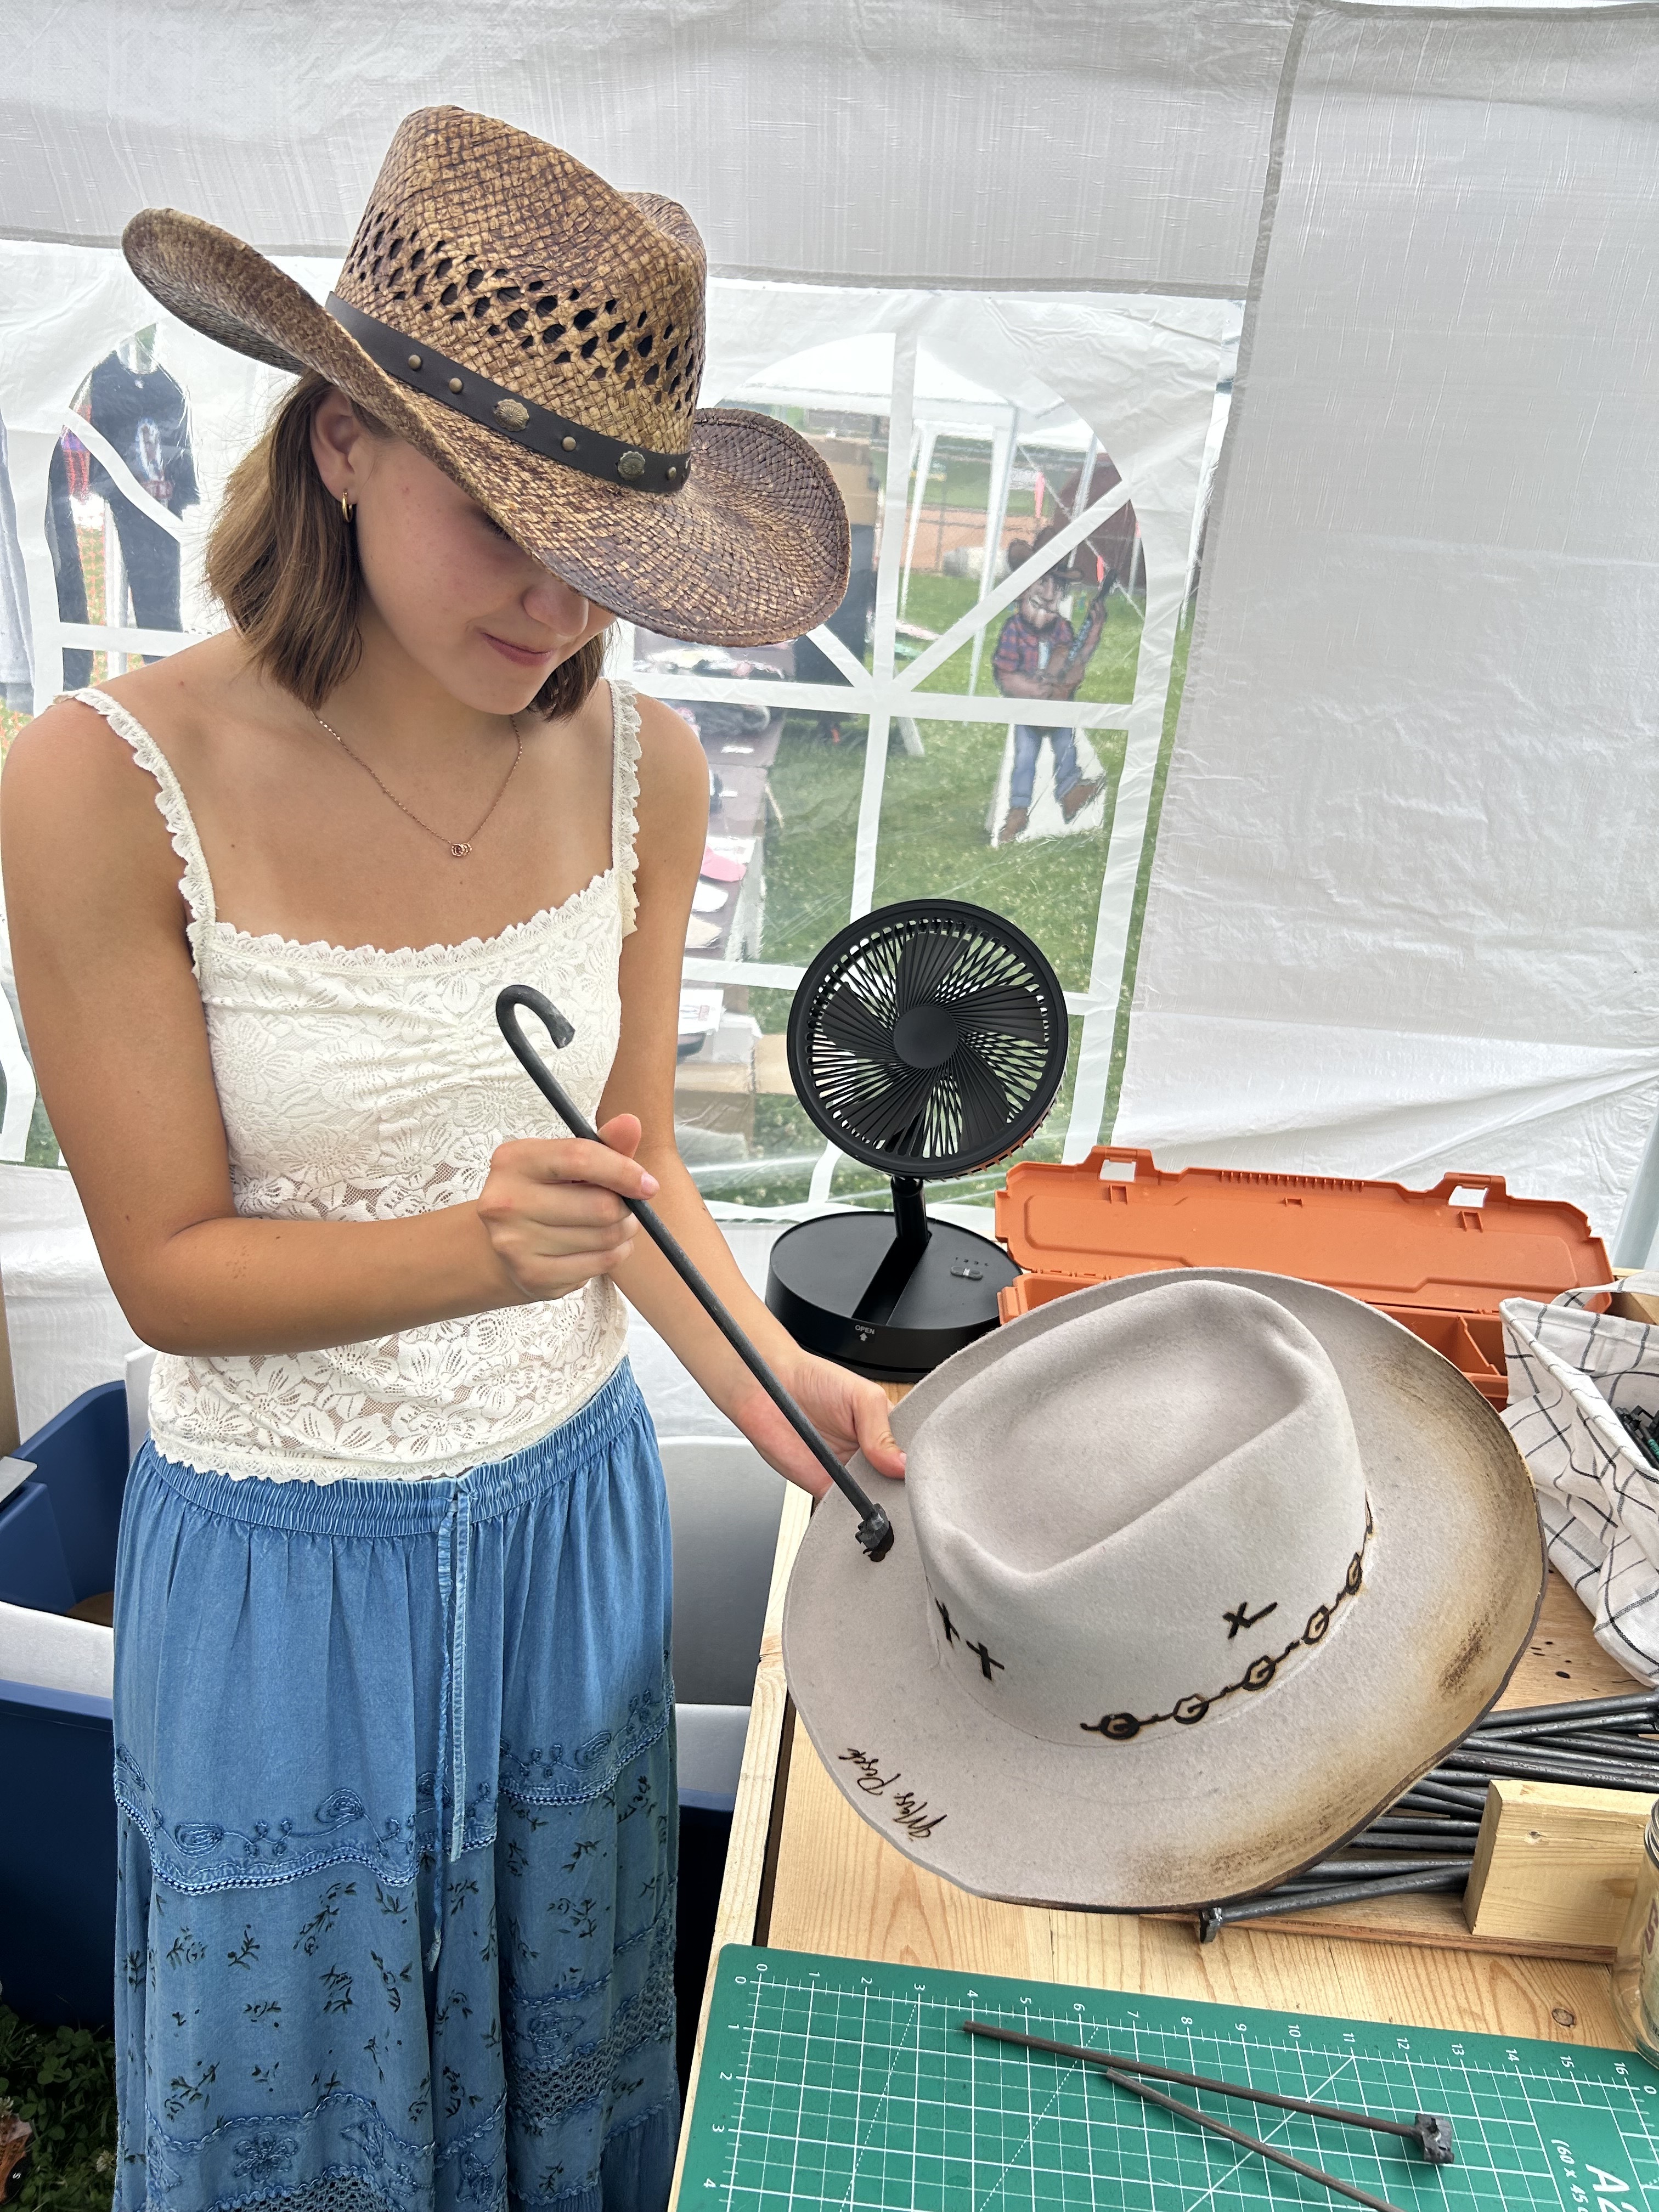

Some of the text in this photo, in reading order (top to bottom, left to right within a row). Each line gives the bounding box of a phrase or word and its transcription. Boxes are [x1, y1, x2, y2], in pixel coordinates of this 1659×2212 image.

[855, 1324, 875, 1334] OPEN
[735, 1976, 747, 1985] 0
[757, 1963, 768, 1972] 0
[861, 1976, 873, 1985] 2
[914, 1983, 926, 1991] 3
[967, 1989, 979, 1997] 4
[1020, 1996, 1032, 2005] 5
[1073, 2003, 1085, 2011] 6
[1181, 2016, 1193, 2025] 8
[1234, 2023, 1247, 2032] 9
[1288, 2024, 1301, 2038] 10
[1342, 2032, 1356, 2042] 11
[1396, 2037, 1410, 2050] 12
[1451, 2043, 1465, 2056] 13
[1505, 2049, 1520, 2062] 14
[1560, 2055, 1575, 2068] 15
[1613, 2062, 1629, 2075] 16
[720, 2071, 732, 2081] 2
[1644, 2085, 1657, 2095] 0
[712, 2123, 725, 2133] 3
[1551, 2139, 1575, 2164] (60
[1564, 2167, 1577, 2179] x
[703, 2177, 717, 2188] 4
[1570, 2183, 1589, 2204] 45
